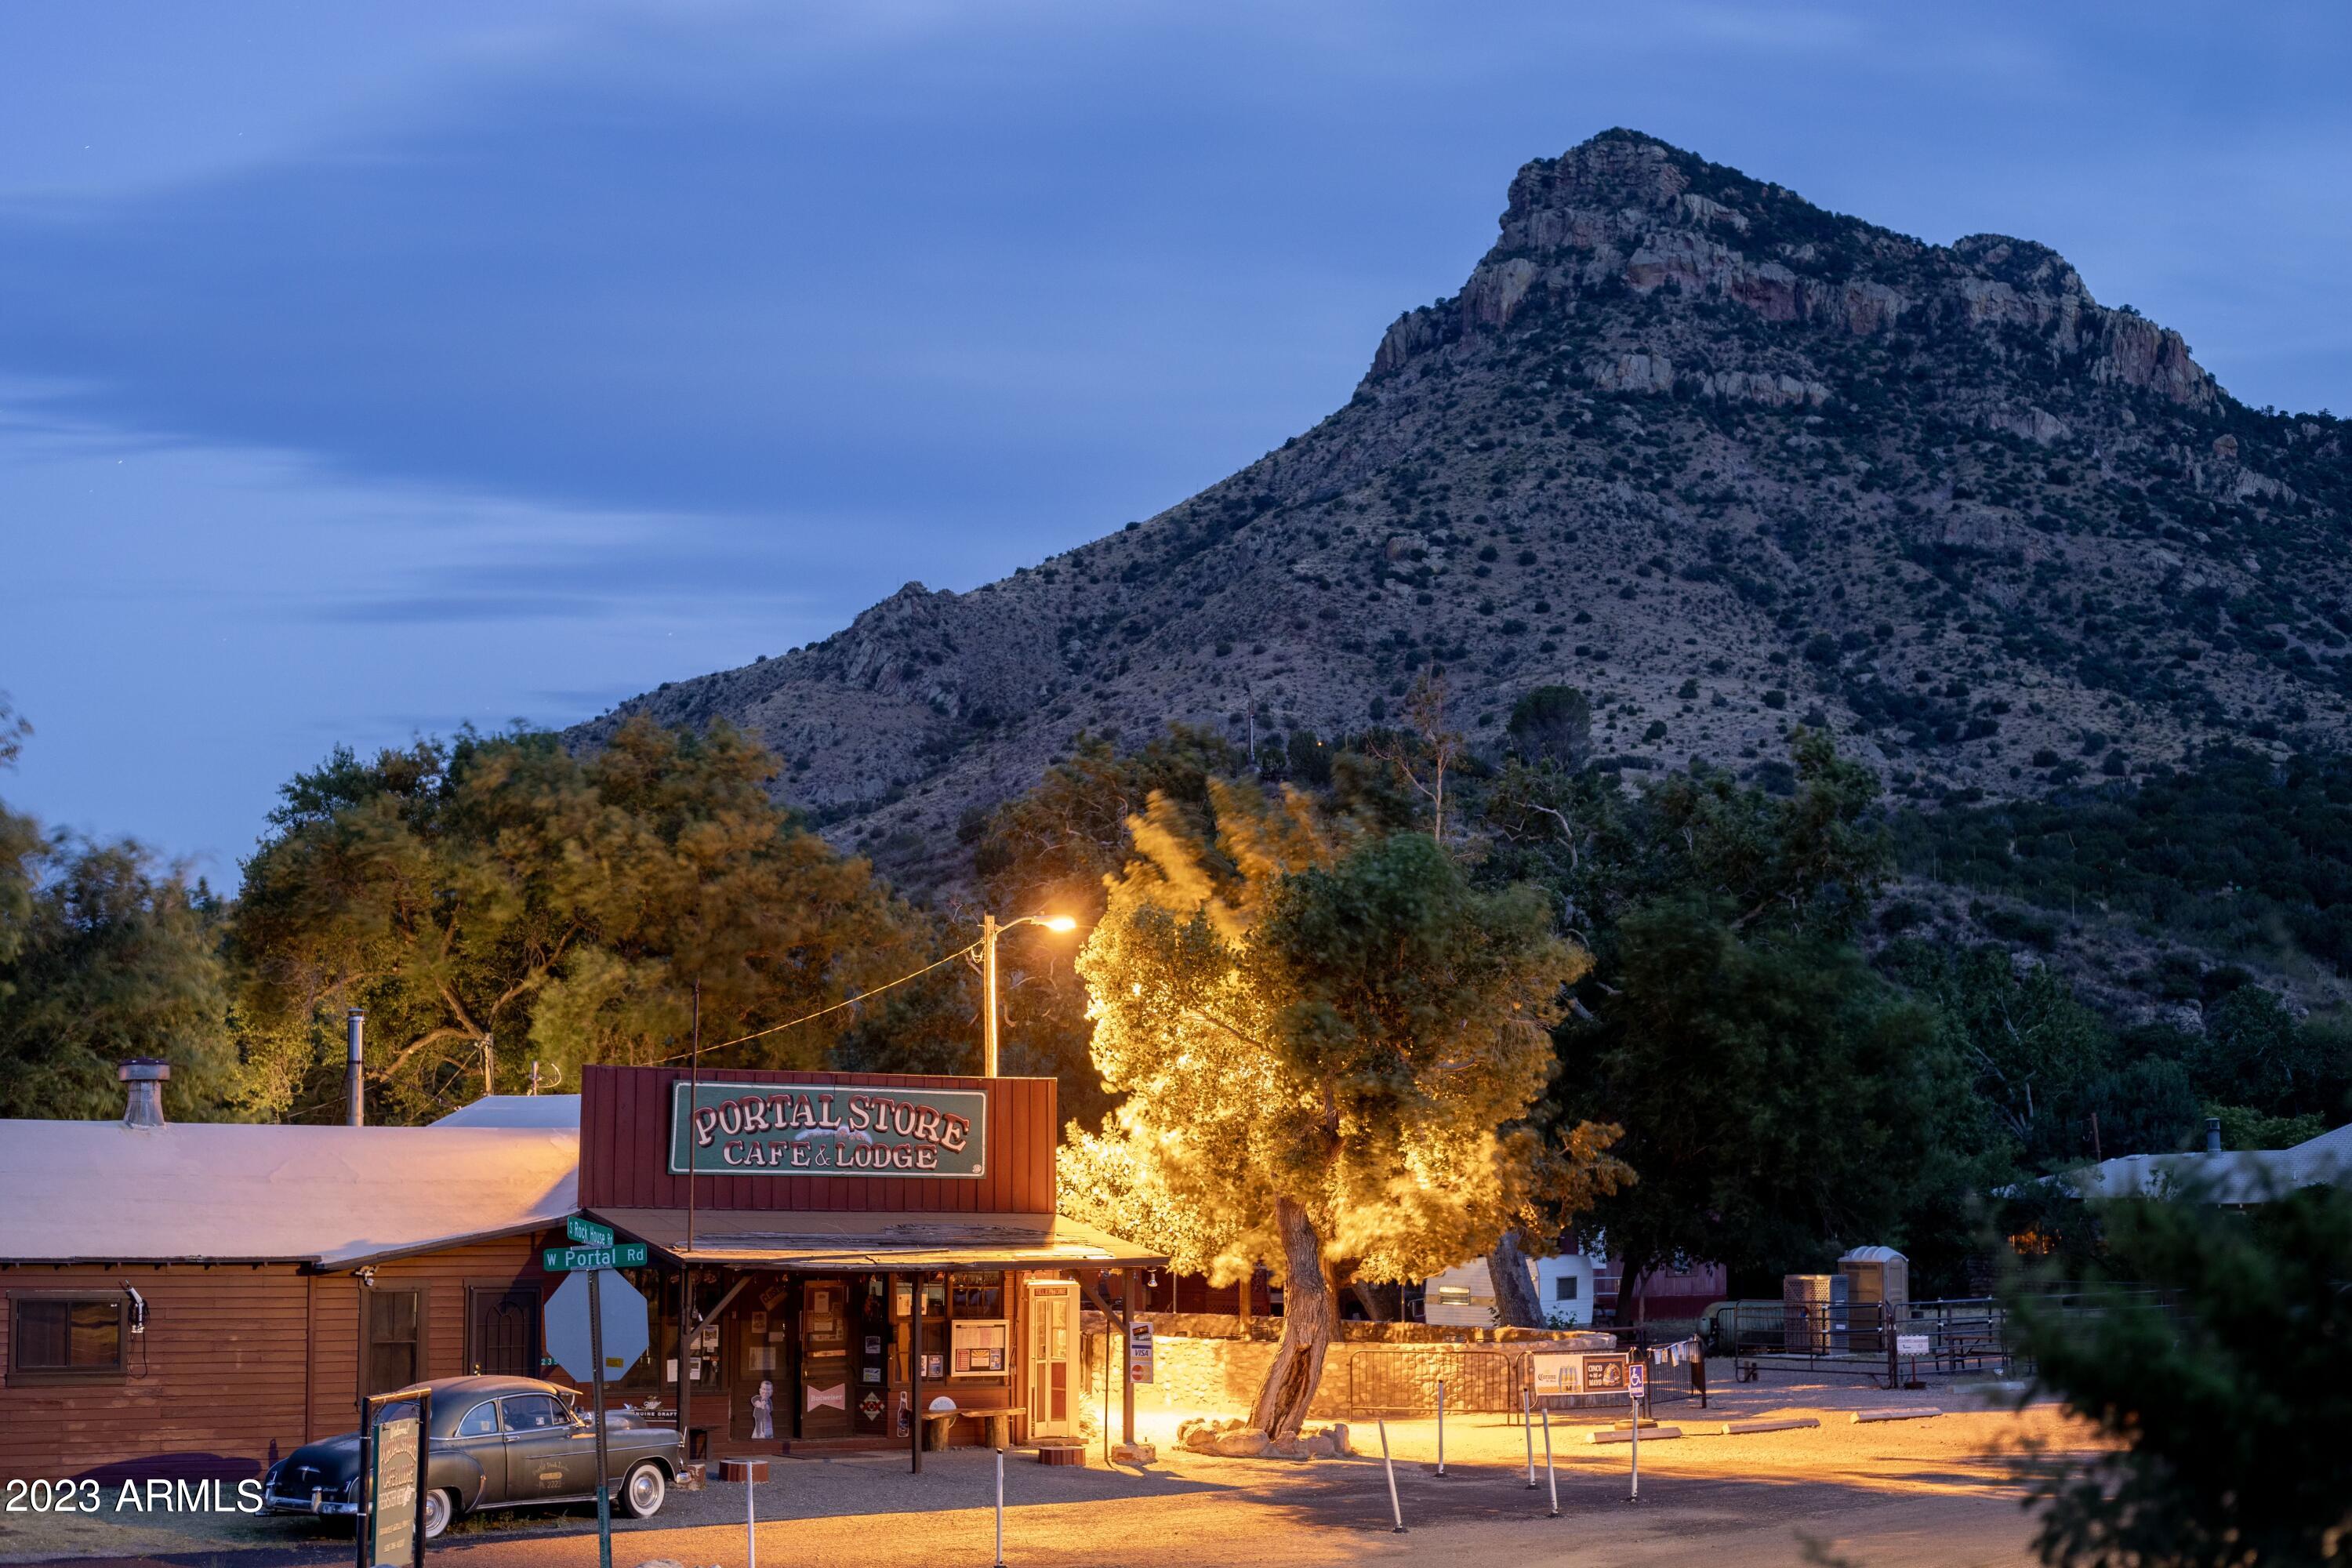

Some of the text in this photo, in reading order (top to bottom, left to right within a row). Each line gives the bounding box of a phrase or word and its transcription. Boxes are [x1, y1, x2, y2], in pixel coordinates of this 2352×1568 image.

[693, 1094, 971, 1154] PORTAL STORE
[723, 1140, 938, 1171] CAFE & LODGE
[569, 1221, 612, 1245] S Rock House Rd
[546, 1248, 644, 1267] W Portal Rd
[1588, 1364, 1602, 1373] CINCO
[1588, 1378, 1602, 1387] MAYO
[379, 1436, 401, 1475] PORTAL
